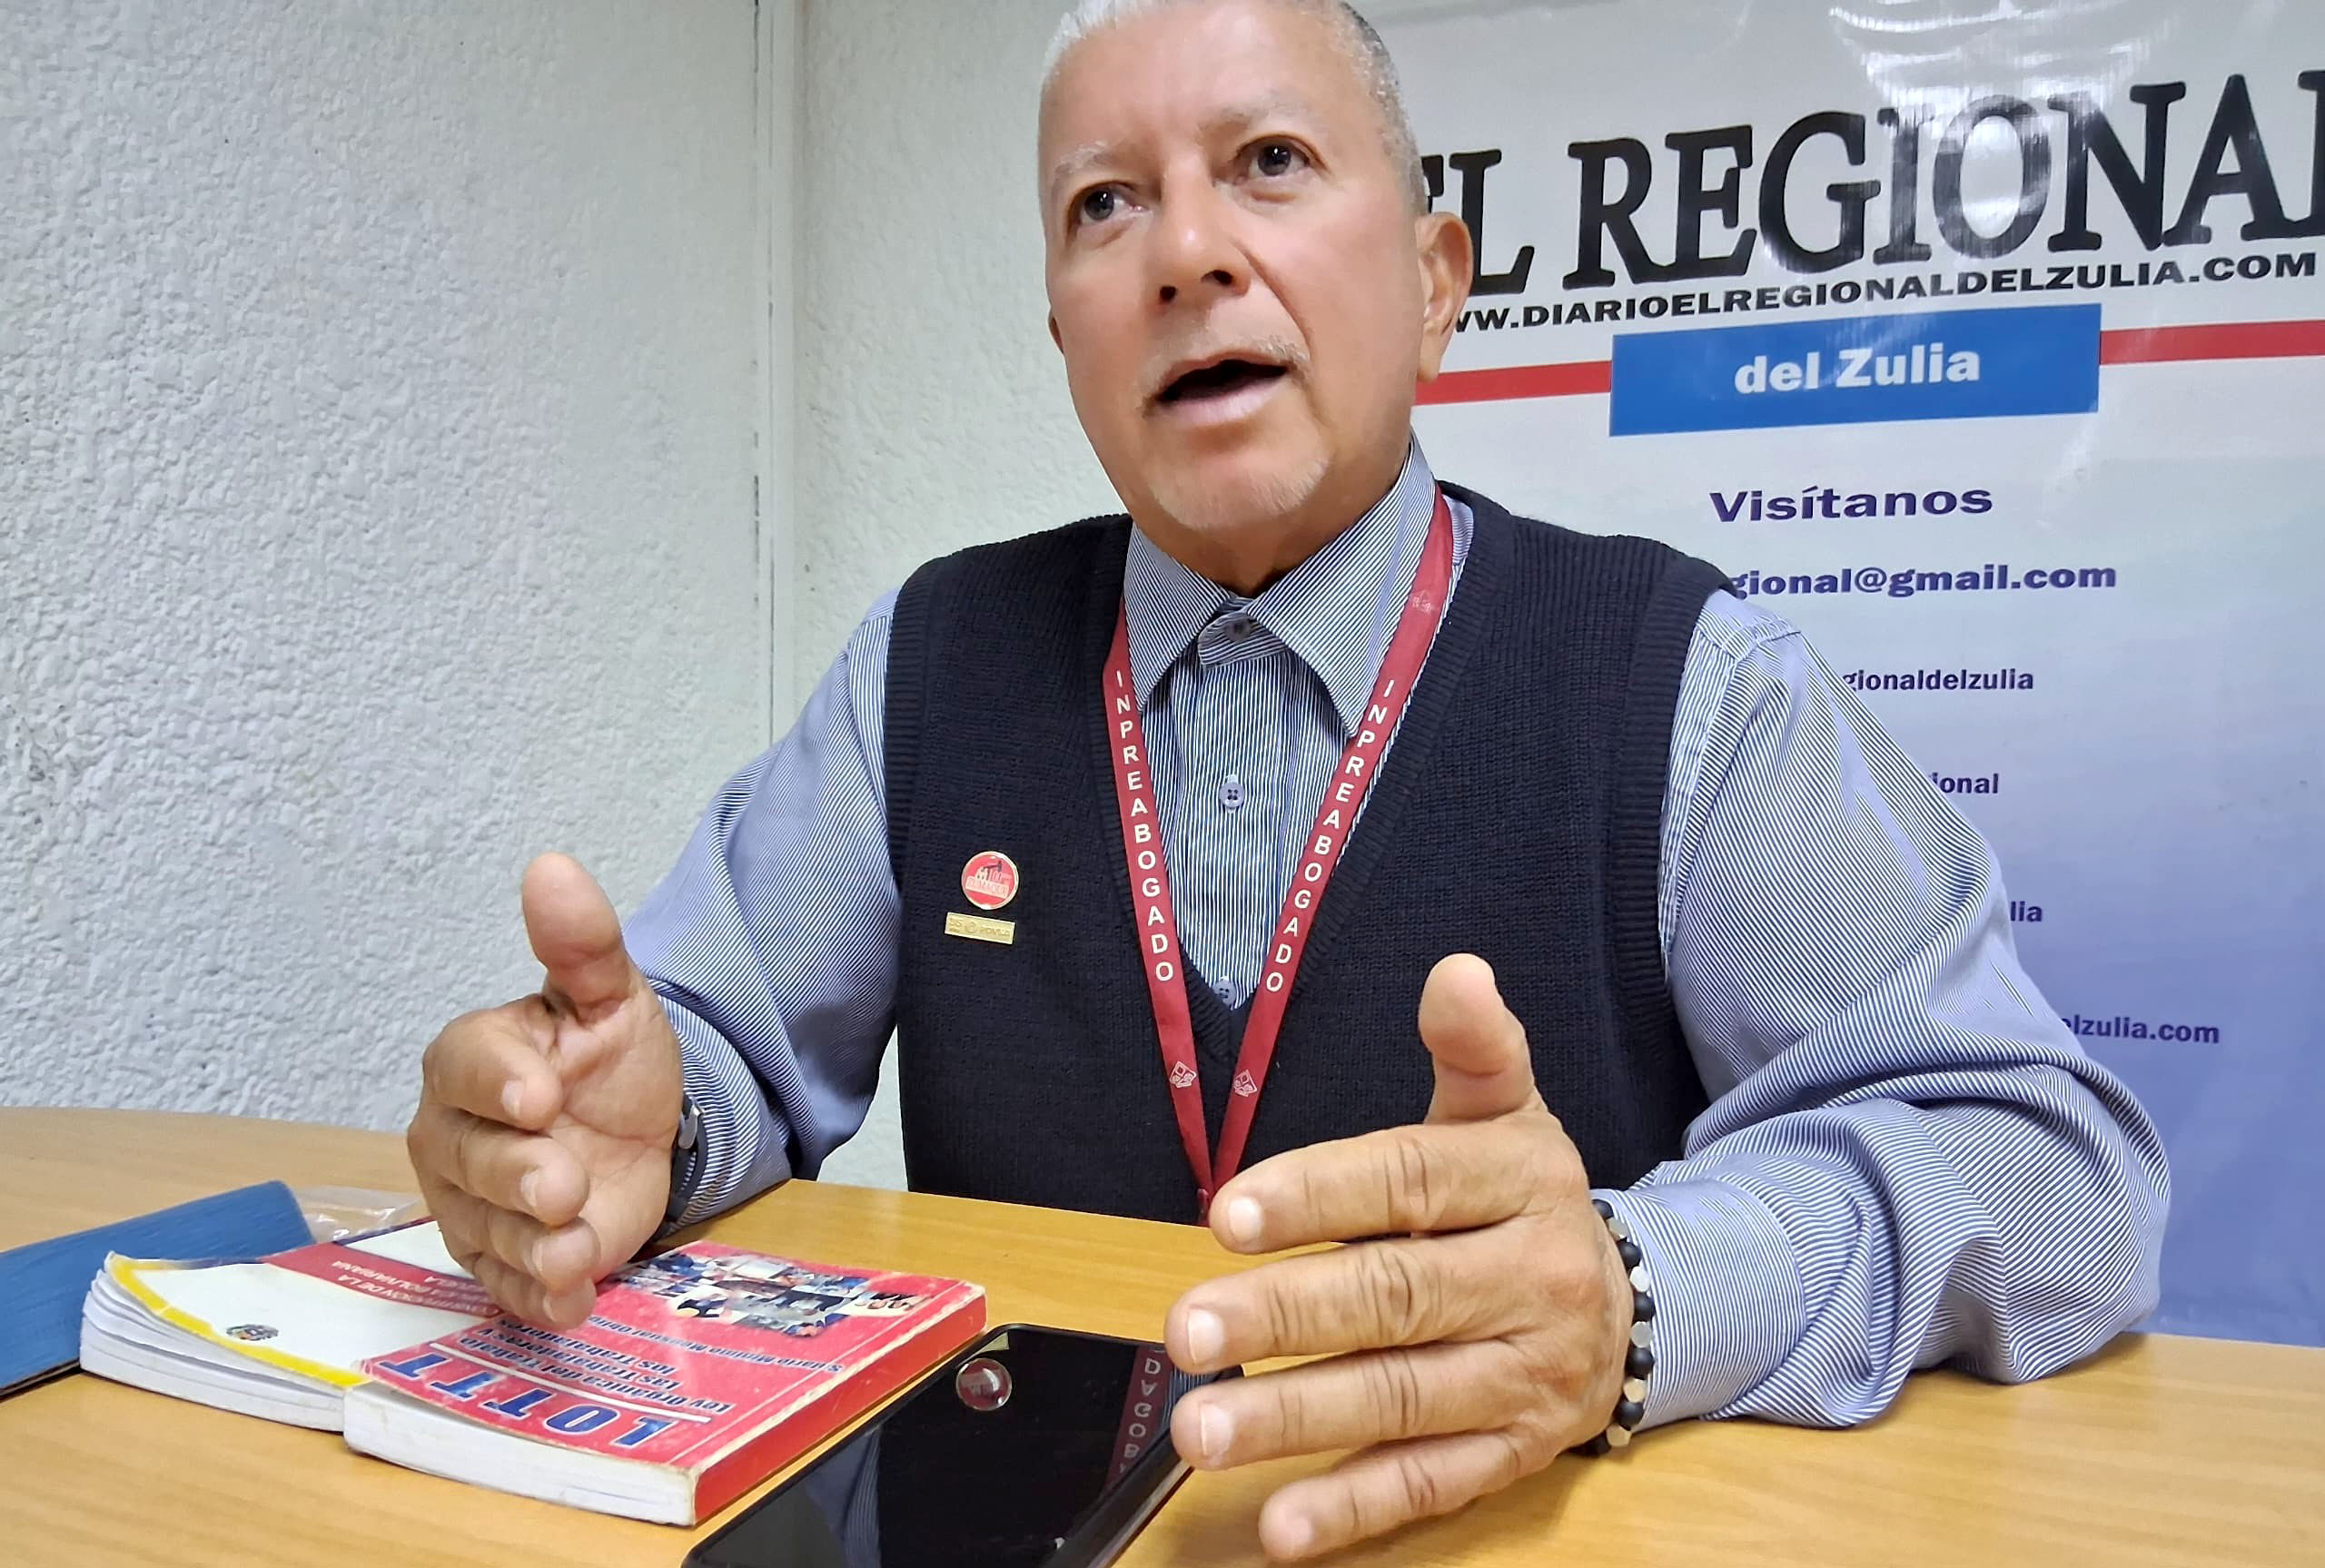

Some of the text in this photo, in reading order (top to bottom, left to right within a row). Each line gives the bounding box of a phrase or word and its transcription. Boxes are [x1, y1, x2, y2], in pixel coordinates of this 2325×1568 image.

[1734, 342, 1981, 394] del Zulia
[1710, 486, 1994, 523] Visítanos
[1115, 670, 1175, 981] INPREABOGADO
[1265, 679, 1396, 992] INPREABOGADO
[379, 1352, 679, 1447] LOTTT
